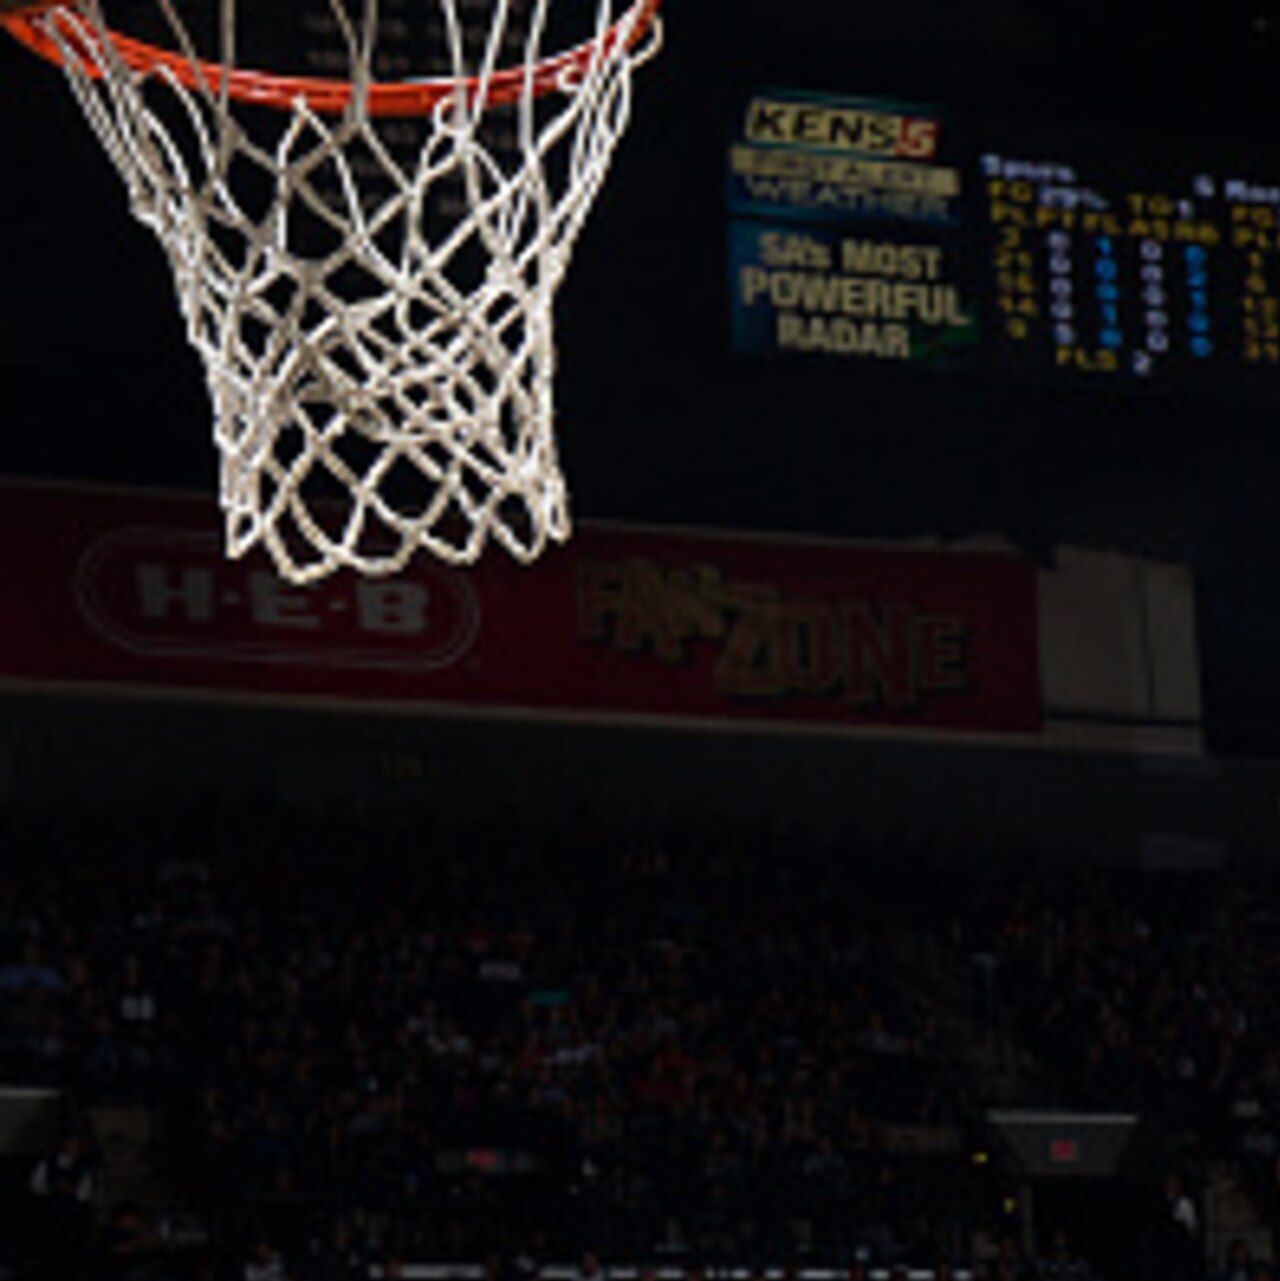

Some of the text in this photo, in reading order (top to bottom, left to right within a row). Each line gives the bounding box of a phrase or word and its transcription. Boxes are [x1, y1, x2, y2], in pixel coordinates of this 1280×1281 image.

[840, 236, 943, 282] MOST
[738, 264, 976, 327] POWERFUL
[776, 310, 912, 360] RADAR
